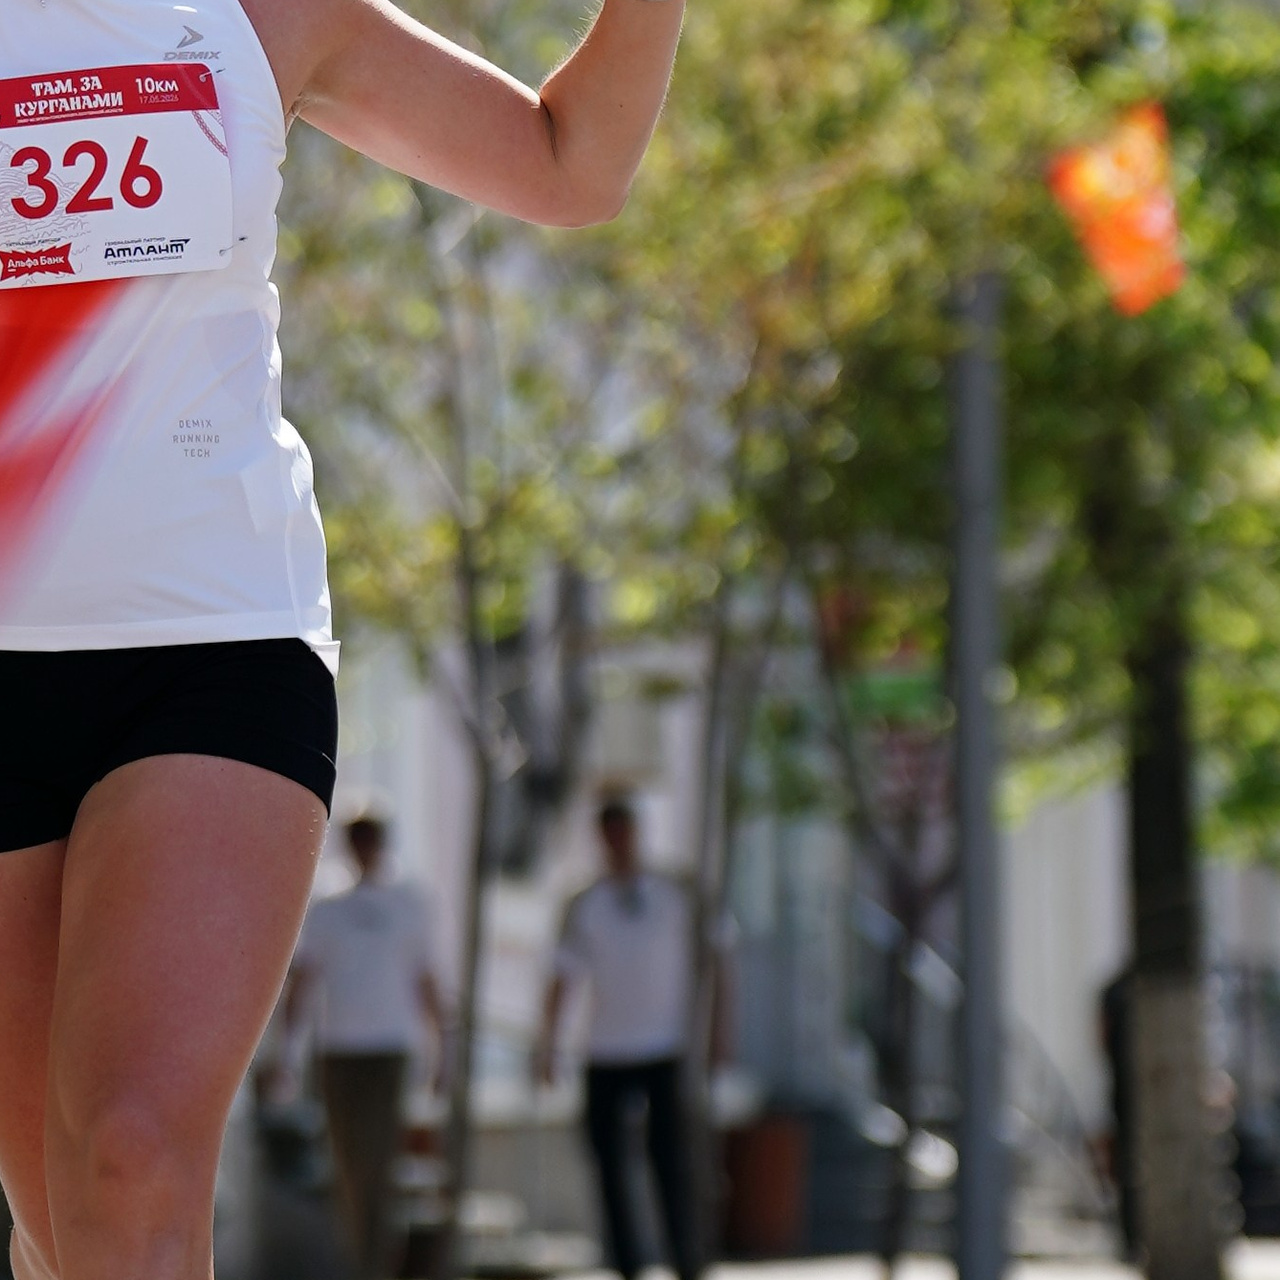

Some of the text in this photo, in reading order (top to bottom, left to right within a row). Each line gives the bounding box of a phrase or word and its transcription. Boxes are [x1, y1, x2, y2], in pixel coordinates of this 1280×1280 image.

[163, 51, 221, 61] DEMIX
[31, 76, 103, 95] ТАМ, ЗА
[14, 91, 124, 118] КУРГАНАМИ
[10, 135, 163, 220] 326
[7, 255, 65, 272] Альфа Банк
[178, 419, 213, 429] DEMIX
[172, 434, 220, 444] RUNNING
[183, 448, 211, 458] TECH
